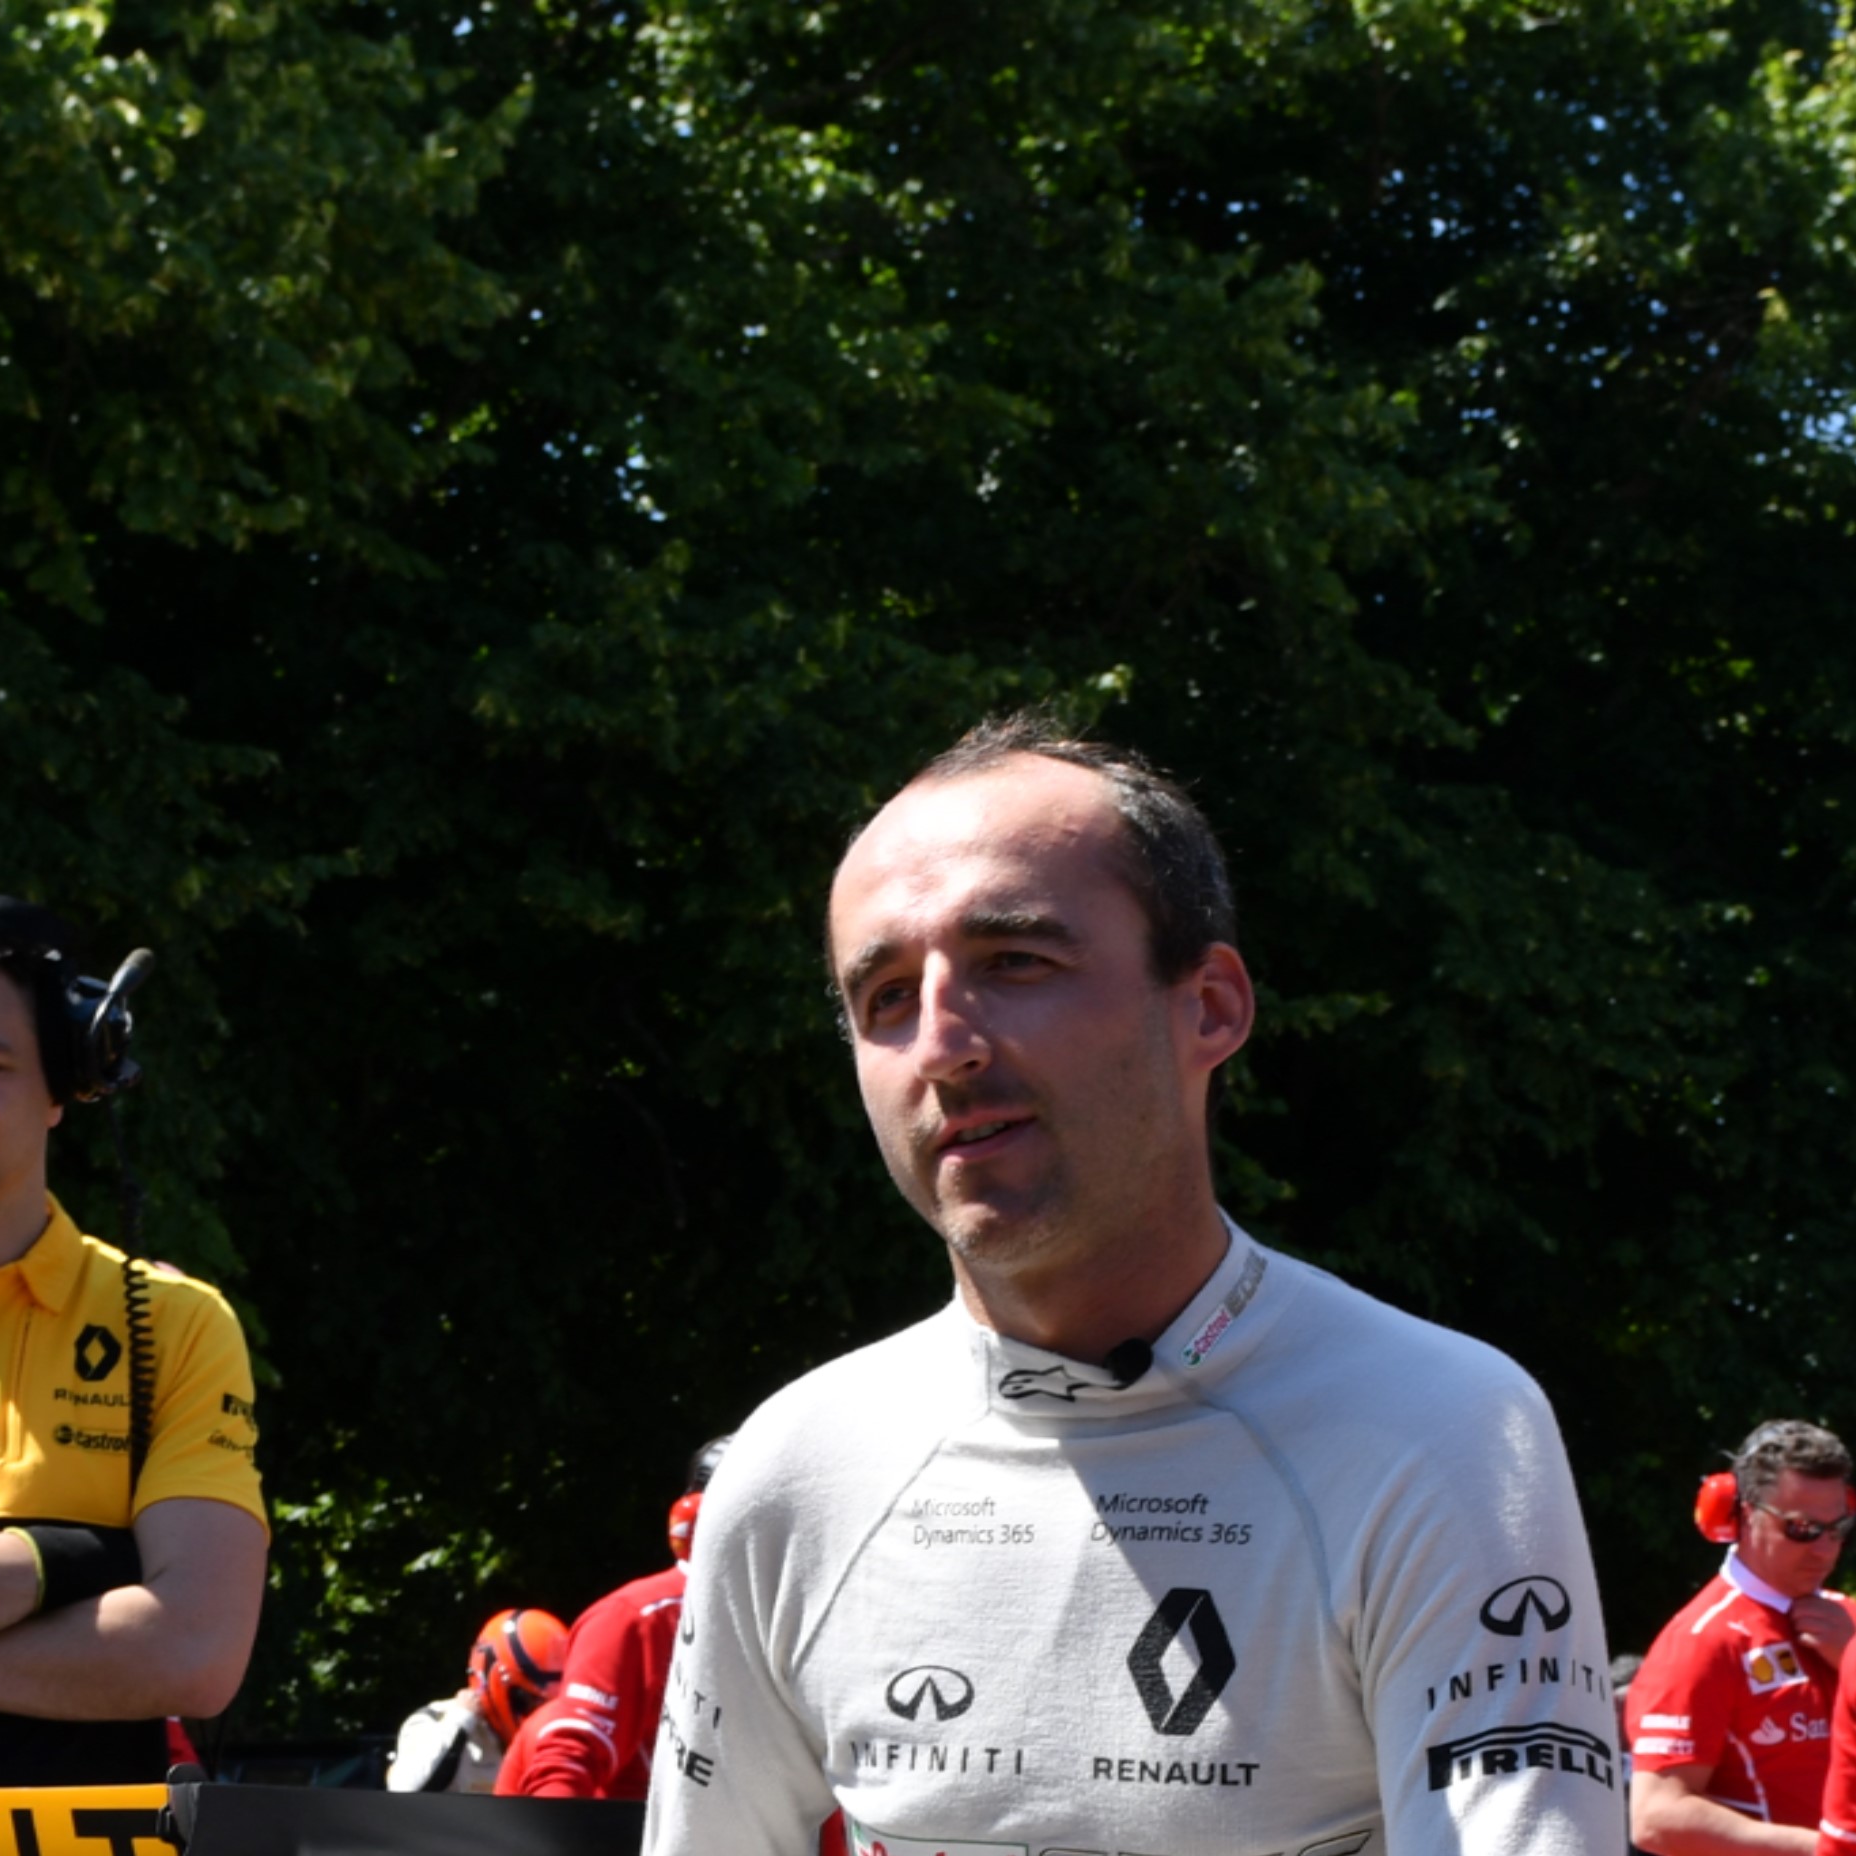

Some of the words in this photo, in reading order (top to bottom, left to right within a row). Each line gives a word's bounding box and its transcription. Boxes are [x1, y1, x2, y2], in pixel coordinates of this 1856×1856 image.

[911, 1498, 996, 1518] Microsoft
[1096, 1494, 1210, 1515] Microsoft
[913, 1523, 994, 1549] Dynamics
[1000, 1523, 1036, 1545] 365
[1091, 1522, 1203, 1548] Dynamics
[1208, 1523, 1253, 1545] 365
[1427, 1656, 1607, 1713] INFINITI
[850, 1741, 1024, 1776] INFINITI
[1426, 1722, 1615, 1792] PIRELLI
[1093, 1757, 1262, 1787] RENAULT
